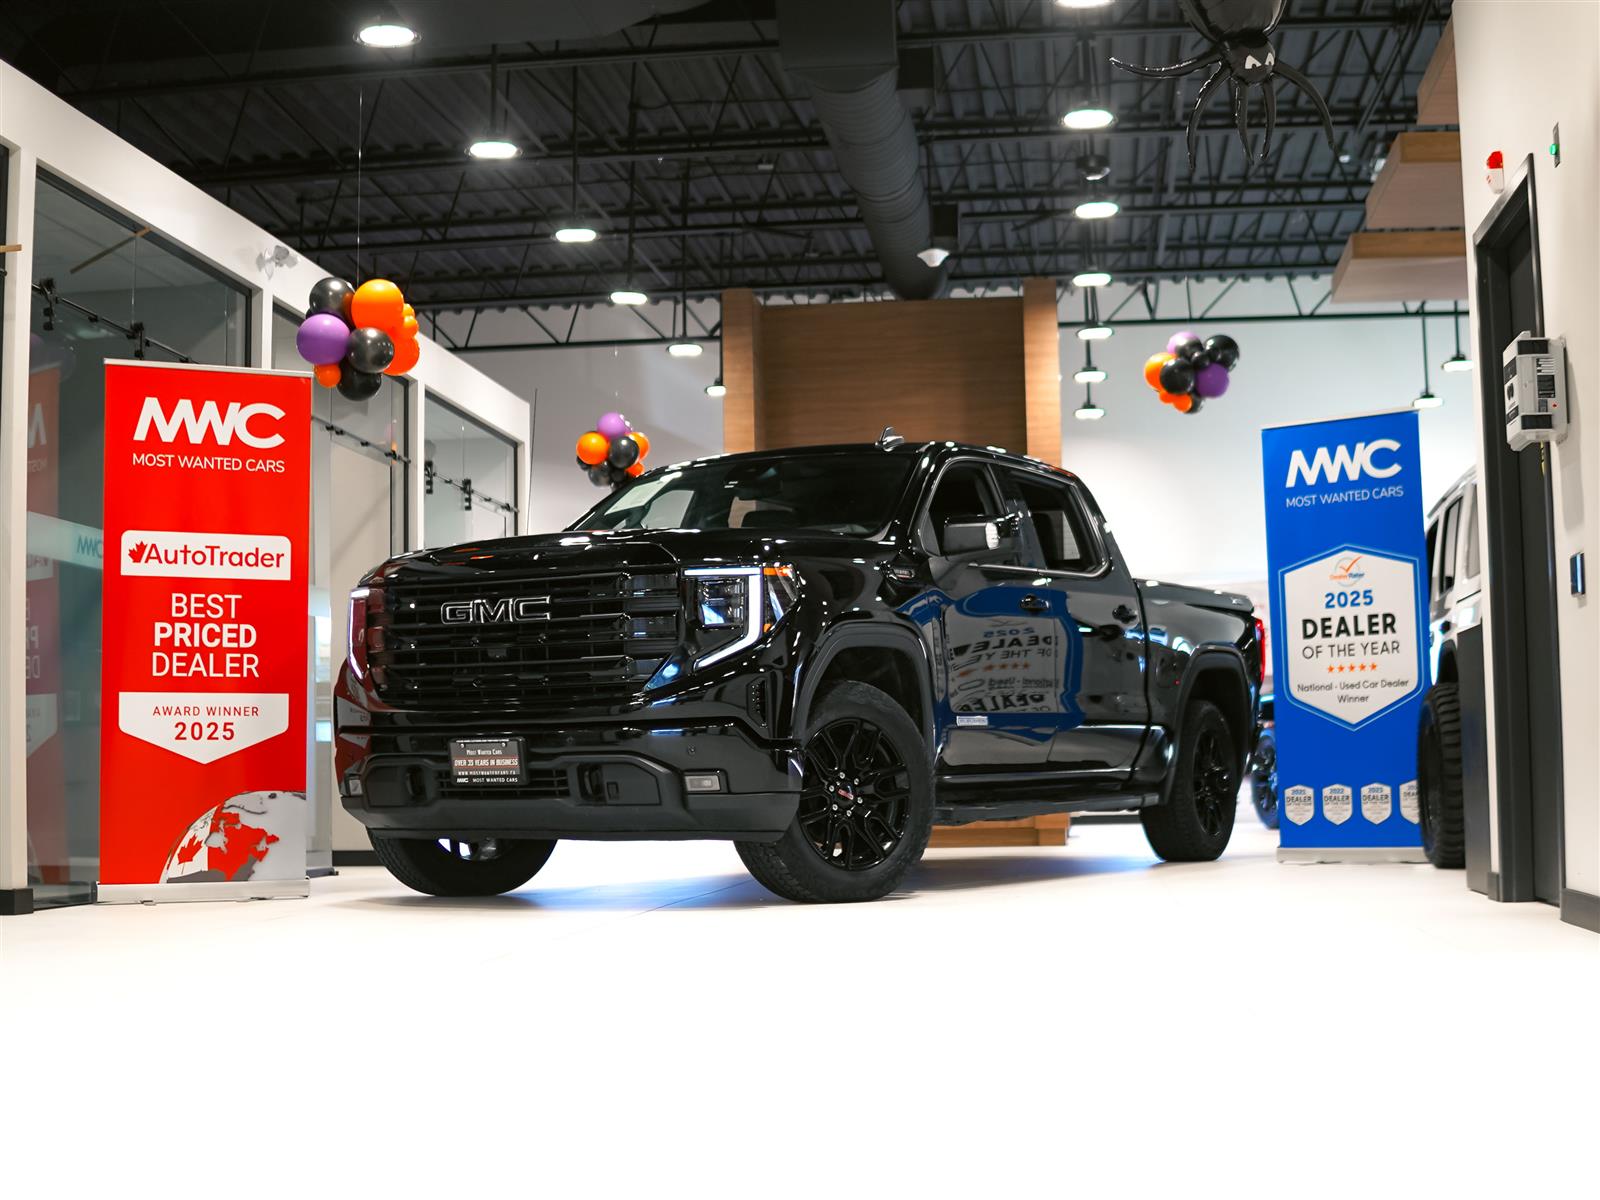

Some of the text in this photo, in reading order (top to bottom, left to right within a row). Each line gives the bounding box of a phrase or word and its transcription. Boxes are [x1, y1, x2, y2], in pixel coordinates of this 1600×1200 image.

[133, 397, 286, 448] MWC
[132, 453, 286, 473] MOST WANTED CARS
[1286, 438, 1402, 488] MWC
[1286, 486, 1404, 508] MOST WANTED CARS
[144, 543, 285, 569] AutoTrader
[171, 593, 242, 619] BEST
[440, 596, 550, 624] GMC
[1325, 590, 1374, 608] 2025
[154, 622, 257, 648] PRICED
[1302, 613, 1396, 640] DEALER
[1302, 640, 1400, 660] OF THE YEAR
[152, 652, 260, 678] DEALER
[1297, 682, 1333, 692] National
[1340, 680, 1361, 690] Used
[1362, 680, 1379, 689] Car
[1381, 678, 1409, 688] Dealer
[1338, 694, 1369, 704] Winner
[152, 706, 260, 717] AWARD WINNER
[174, 722, 235, 741] 2025
